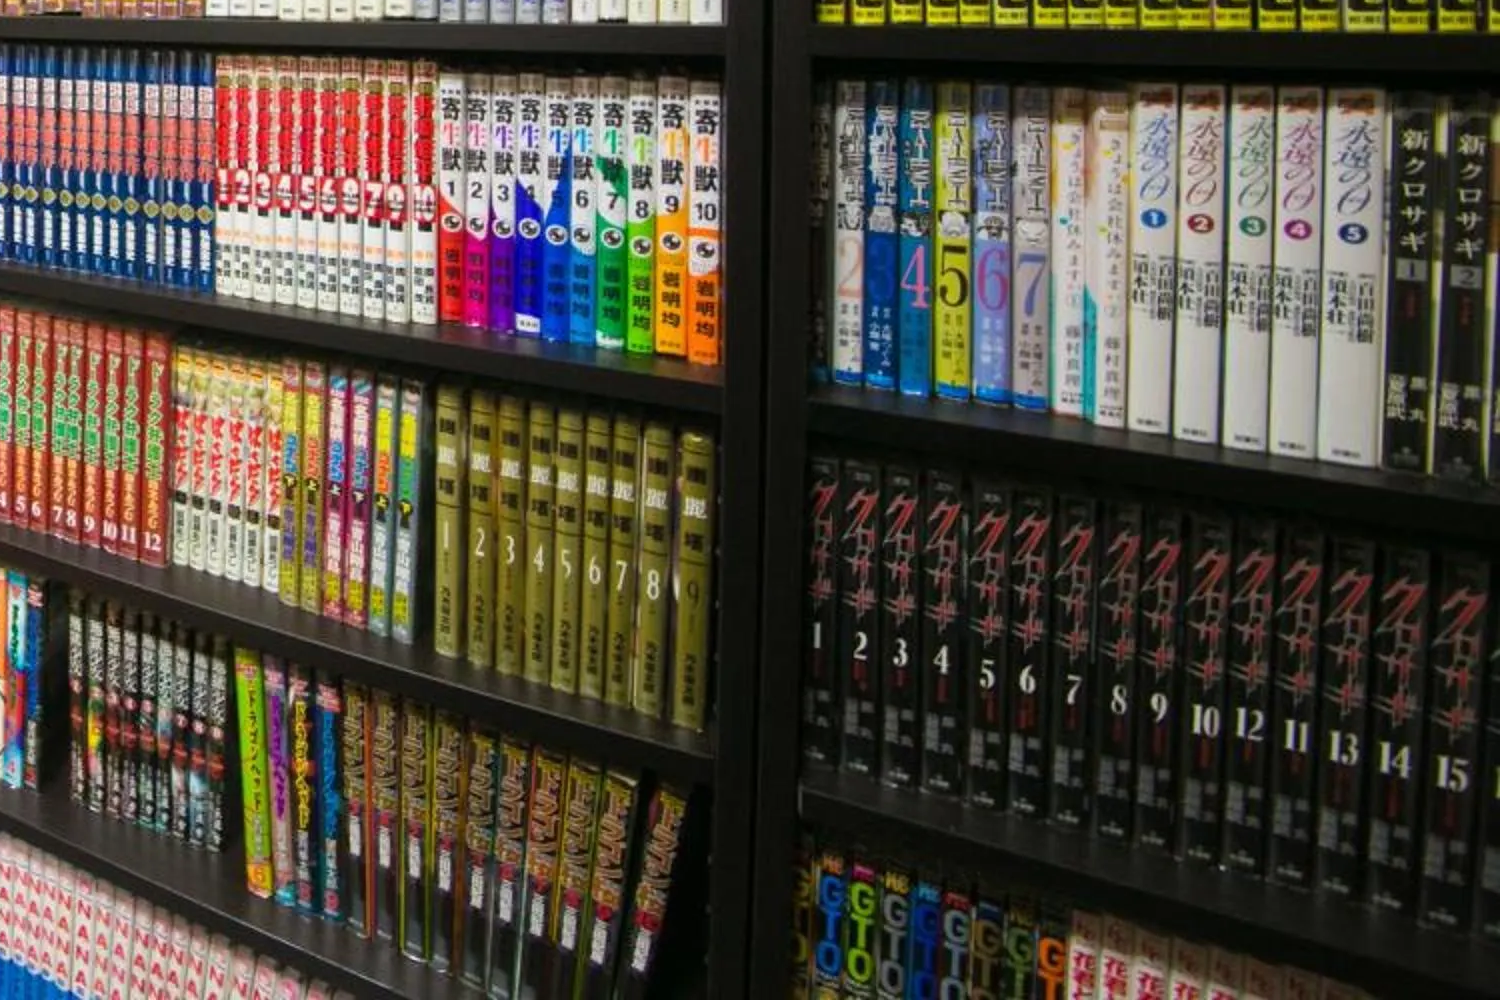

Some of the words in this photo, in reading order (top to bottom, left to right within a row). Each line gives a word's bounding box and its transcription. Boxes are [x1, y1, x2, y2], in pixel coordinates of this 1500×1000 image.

[441, 98, 461, 172] 寄生獣
[466, 99, 488, 173] 寄生獣
[493, 100, 514, 175] 寄生獣
[520, 98, 541, 174] 寄生獣
[547, 103, 570, 181] 寄生獣
[572, 101, 595, 180] 寄生獣
[603, 103, 625, 184] 寄生獣
[631, 109, 652, 190] 寄生獣
[661, 103, 684, 185] 寄生獣
[694, 110, 718, 192] 寄生獣
[256, 172, 271, 208] 3
[300, 175, 316, 211] 5
[366, 183, 382, 220] 7
[413, 185, 434, 221] 10
[447, 182, 455, 196] 1
[471, 181, 482, 198] 2
[497, 185, 509, 201] 3
[576, 190, 589, 208] 6
[607, 192, 618, 210] 7
[665, 195, 678, 213] 9
[1401, 128, 1428, 252] 新クロサギ
[1455, 134, 1486, 258] 新クロサギ
[635, 200, 648, 218] 8
[695, 203, 716, 221] 10
[839, 236, 863, 299] 2
[870, 238, 894, 298] 3
[901, 245, 930, 308] 4
[939, 245, 967, 308] 5
[977, 249, 1008, 310] 6
[1017, 253, 1046, 316] 7
[15, 496, 25, 512] 5
[32, 501, 41, 517] 6
[53, 506, 62, 522] 7
[66, 510, 76, 526] 8
[84, 516, 95, 531] 9
[103, 521, 117, 537] 10
[121, 527, 137, 543] 11
[144, 531, 161, 550] 12
[443, 520, 449, 549] 1
[476, 528, 485, 557] 2
[506, 535, 514, 565] 3
[533, 544, 544, 573] 4
[561, 549, 571, 578] 5
[589, 556, 600, 585] 6
[616, 560, 628, 590] 7
[647, 569, 659, 600] 8
[813, 622, 821, 648] 1
[853, 631, 867, 660] 2
[893, 638, 908, 667] 3
[933, 645, 949, 675] 4
[980, 659, 995, 689] 5
[1019, 664, 1036, 694] 6
[1067, 674, 1083, 705] 7
[1111, 684, 1128, 715] 8
[1150, 693, 1168, 722] 9
[1192, 703, 1220, 738] 10
[1236, 706, 1264, 741] 12
[1285, 719, 1309, 753] 11
[1329, 730, 1359, 766] 13
[1379, 741, 1411, 779] 14
[1436, 755, 1469, 793] 15
[0, 862, 11, 946] NANA
[57, 892, 71, 976] NANA
[815, 875, 844, 976] GTO
[847, 881, 875, 983] GTO
[75, 900, 92, 986] NANA
[94, 907, 111, 993] NANA
[880, 893, 908, 994] GTO
